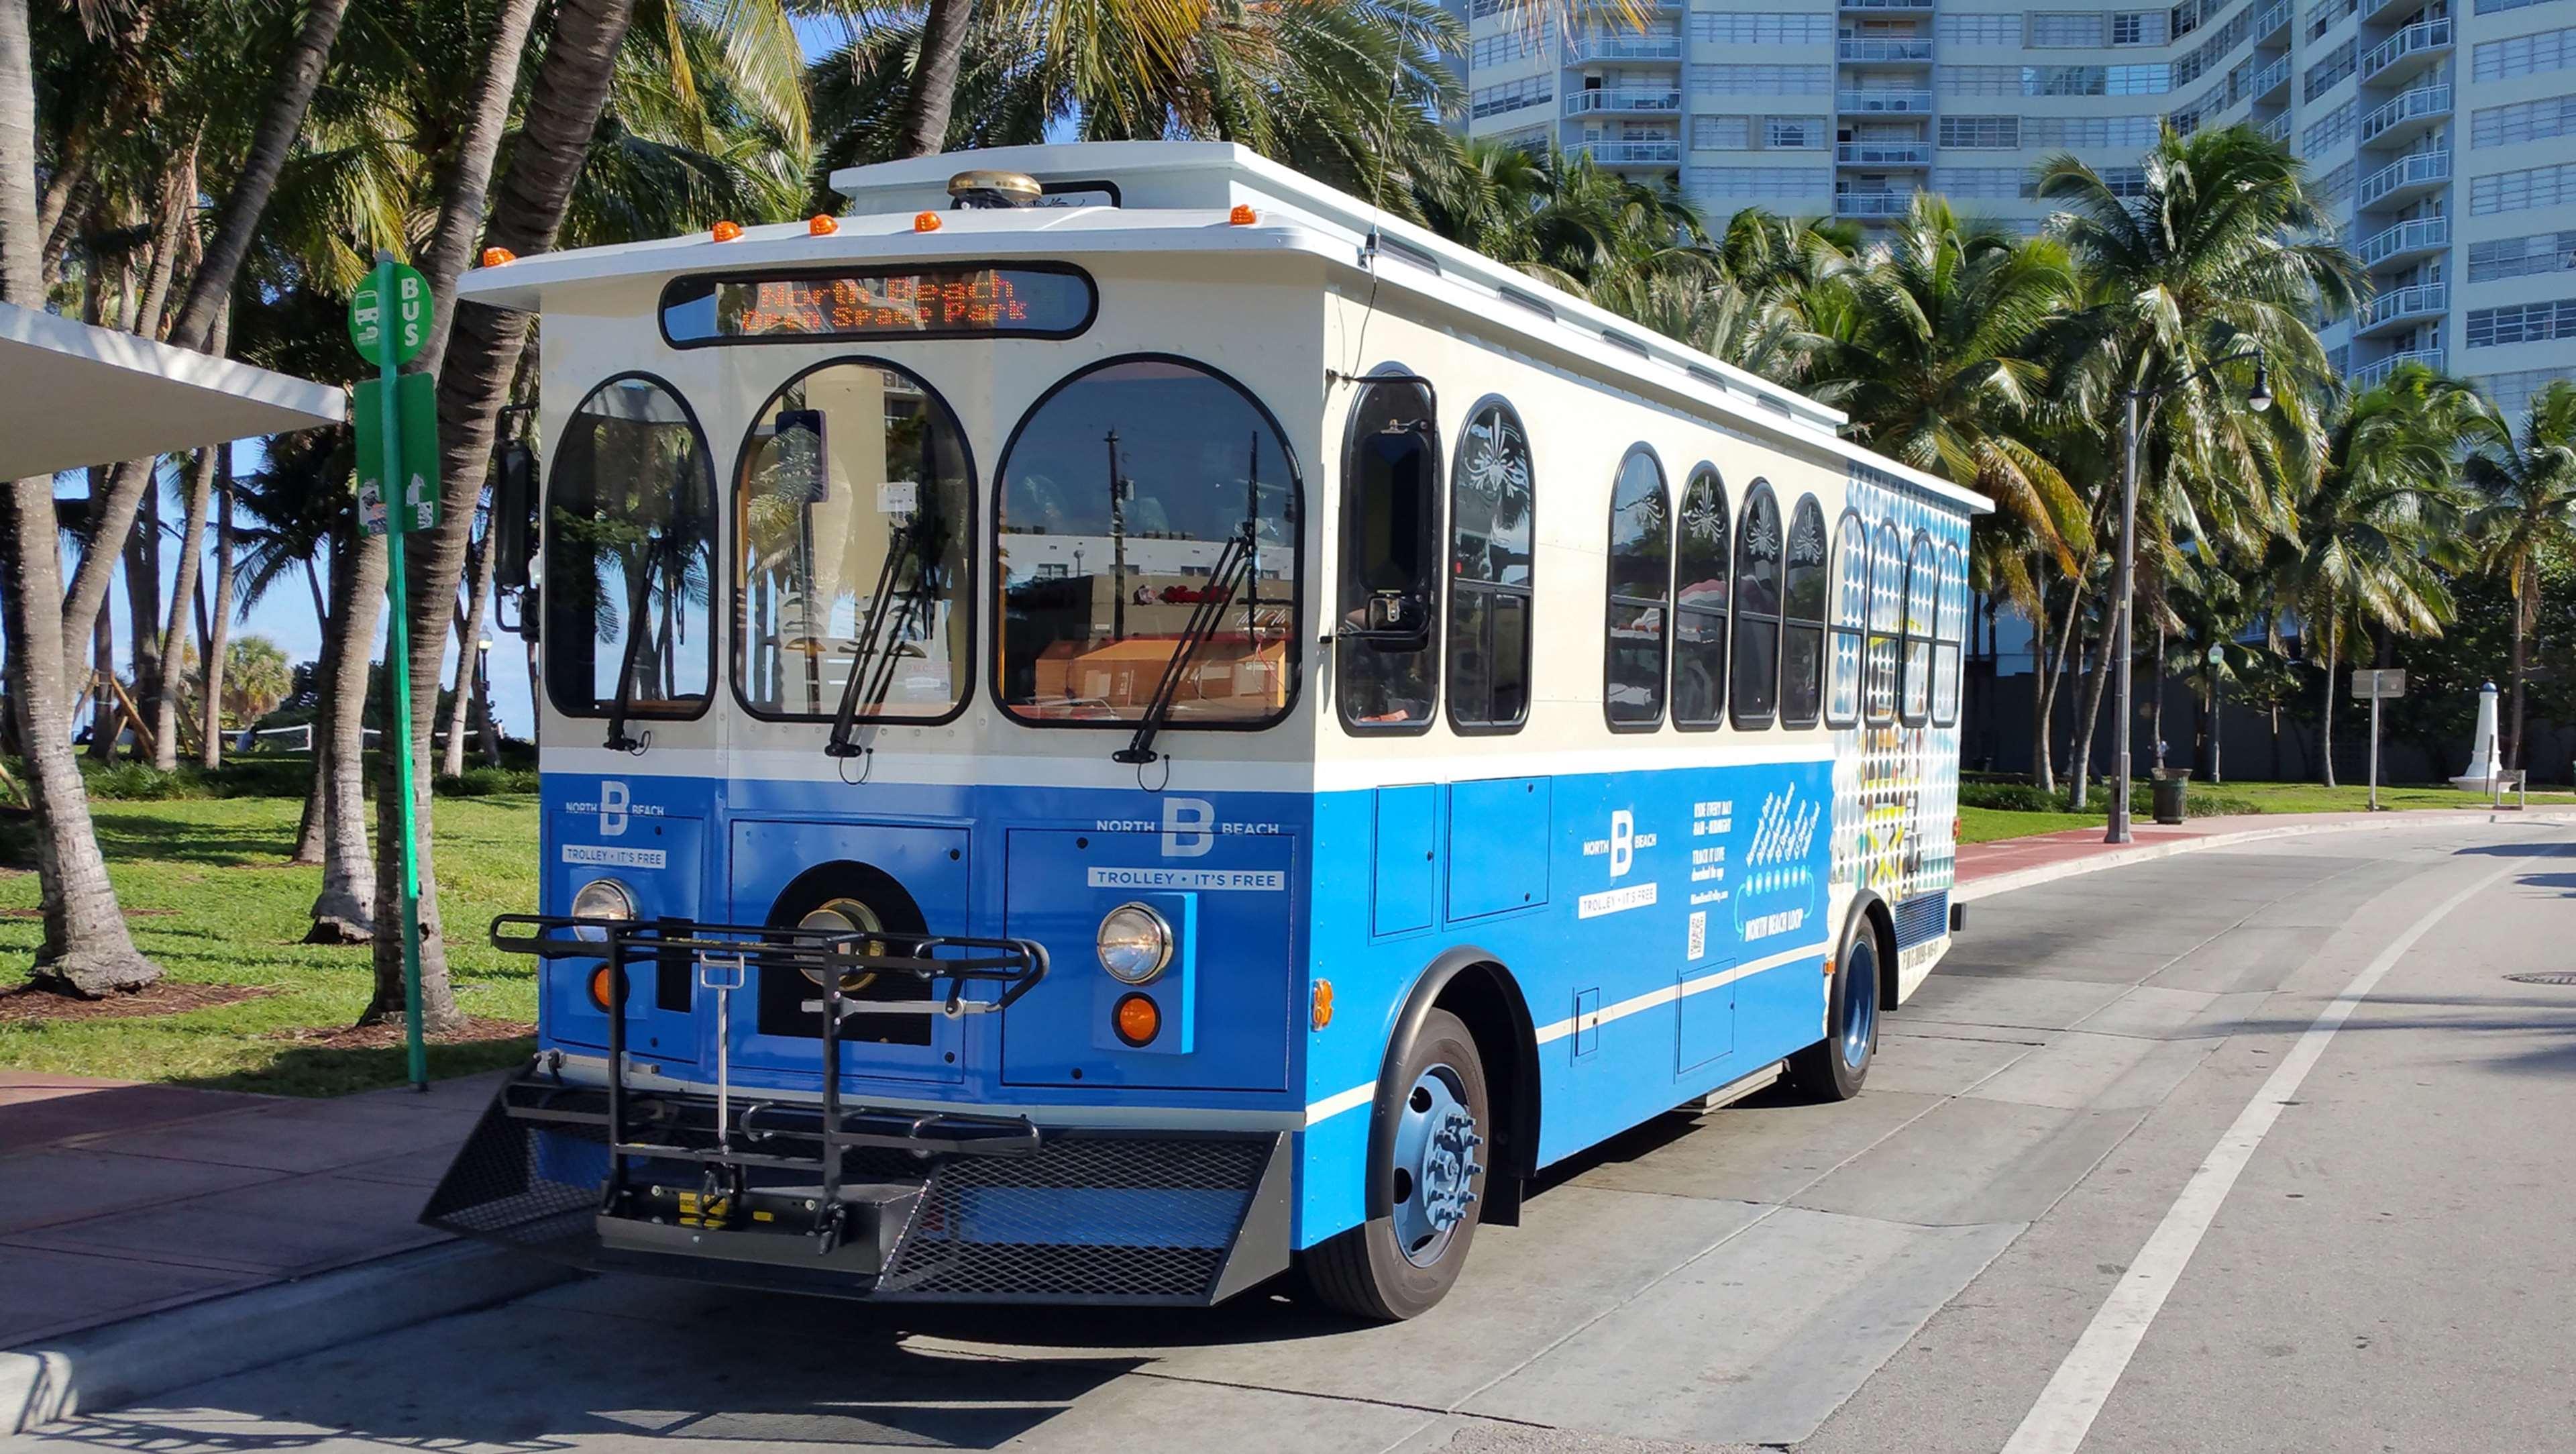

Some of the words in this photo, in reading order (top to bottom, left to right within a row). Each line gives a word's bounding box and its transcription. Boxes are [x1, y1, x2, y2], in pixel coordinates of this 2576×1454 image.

[762, 278, 868, 309] North
[888, 273, 1013, 305] Beach
[401, 276, 419, 346] BUS
[743, 310, 820, 331] Open
[833, 305, 934, 327] Space
[945, 299, 1027, 322] Park
[566, 802, 597, 814] NORTH
[600, 780, 630, 835] B
[632, 805, 665, 817] BEACH
[1096, 820, 1155, 833] NORTH
[1161, 797, 1215, 857] B
[1222, 823, 1279, 835] BEACH
[1583, 839, 1609, 856] NORTH
[1610, 810, 1634, 877] B
[1635, 833, 1657, 849] BEACH
[568, 849, 607, 861] TROLLEY
[617, 851, 635, 863] IT'S
[638, 853, 661, 865] FREE
[1097, 872, 1175, 884] TROLLEY
[1195, 874, 1226, 886] IT'S
[1233, 874, 1276, 886] FREE
[1583, 894, 1616, 913] TROLLEY
[1622, 892, 1638, 904] IT'S
[1638, 887, 1654, 902] FREE
